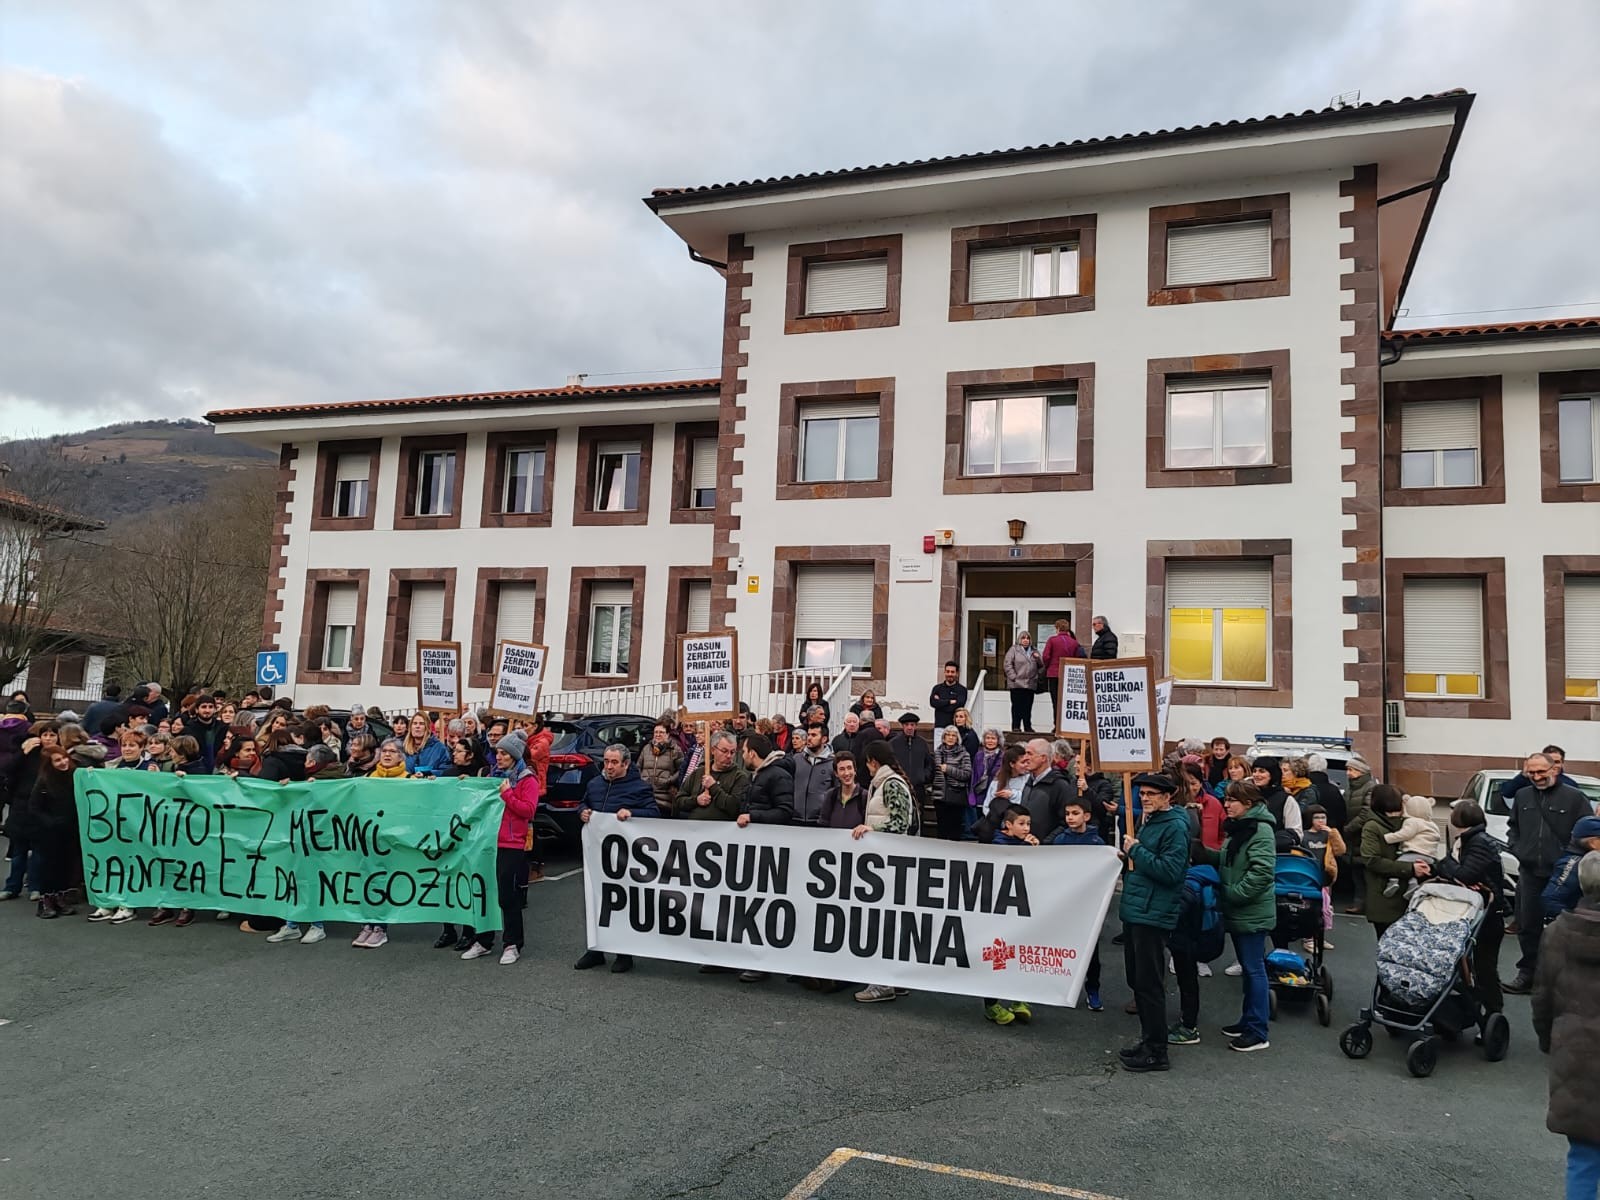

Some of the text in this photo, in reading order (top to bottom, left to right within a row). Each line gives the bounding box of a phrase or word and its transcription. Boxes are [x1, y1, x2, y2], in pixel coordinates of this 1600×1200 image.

[687, 641, 721, 652] OSASUN
[422, 650, 451, 659] OSASUN
[505, 647, 536, 660] OSASUN
[687, 651, 727, 661] ZERBITZU
[423, 658, 456, 668] ZERBITZU
[503, 655, 540, 669] ZERBITZU
[687, 660, 730, 671] PRIBATUEI
[423, 666, 453, 675] PUBLIKO
[502, 664, 535, 677] PUBLIKO
[687, 674, 726, 684] BALIABIDE
[1094, 671, 1125, 683] GUREA
[687, 682, 729, 692] BAKAR BAT
[1095, 681, 1144, 693] PUBLIKOA!
[497, 690, 530, 702] DENONTZAT
[687, 691, 713, 700] ERE EZ
[1096, 693, 1133, 704] OSASUN-
[1097, 703, 1122, 713] BIDEA
[1098, 715, 1135, 728] ZAINDU
[1098, 727, 1146, 740] DEZAGUN
[601, 833, 1032, 917] OSASUN SISTEMA
[275, 865, 298, 906] DA
[598, 882, 971, 968] PUBLIKO DUINA
[1018, 945, 1077, 959] BAZTANGO
[1019, 954, 1063, 968] OSASUN
[1019, 963, 1072, 976] PLATAFORMA
